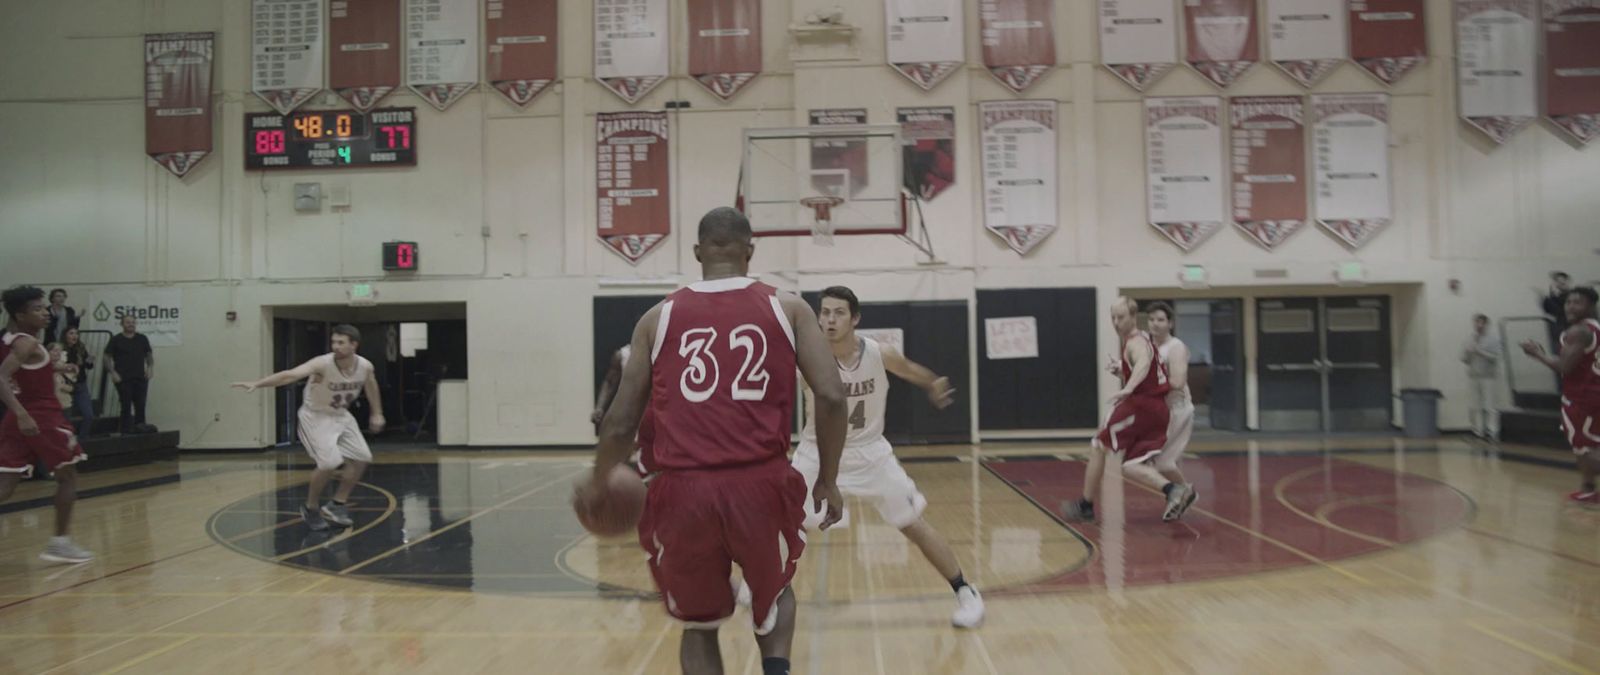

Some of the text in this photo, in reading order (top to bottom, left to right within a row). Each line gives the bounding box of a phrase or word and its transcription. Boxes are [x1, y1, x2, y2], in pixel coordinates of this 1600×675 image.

[252, 116, 283, 128] HOME
[294, 114, 351, 139] 48.0
[371, 111, 413, 124] VISITOR
[255, 130, 285, 154] 80
[380, 126, 410, 149] 77
[598, 119, 668, 142] CHAMPIONS
[337, 147, 351, 163] 4
[397, 243, 413, 269] 0
[114, 305, 179, 320] SiteOne
[679, 324, 770, 403] 32
[843, 378, 875, 396] MANS
[848, 400, 866, 430] 4
